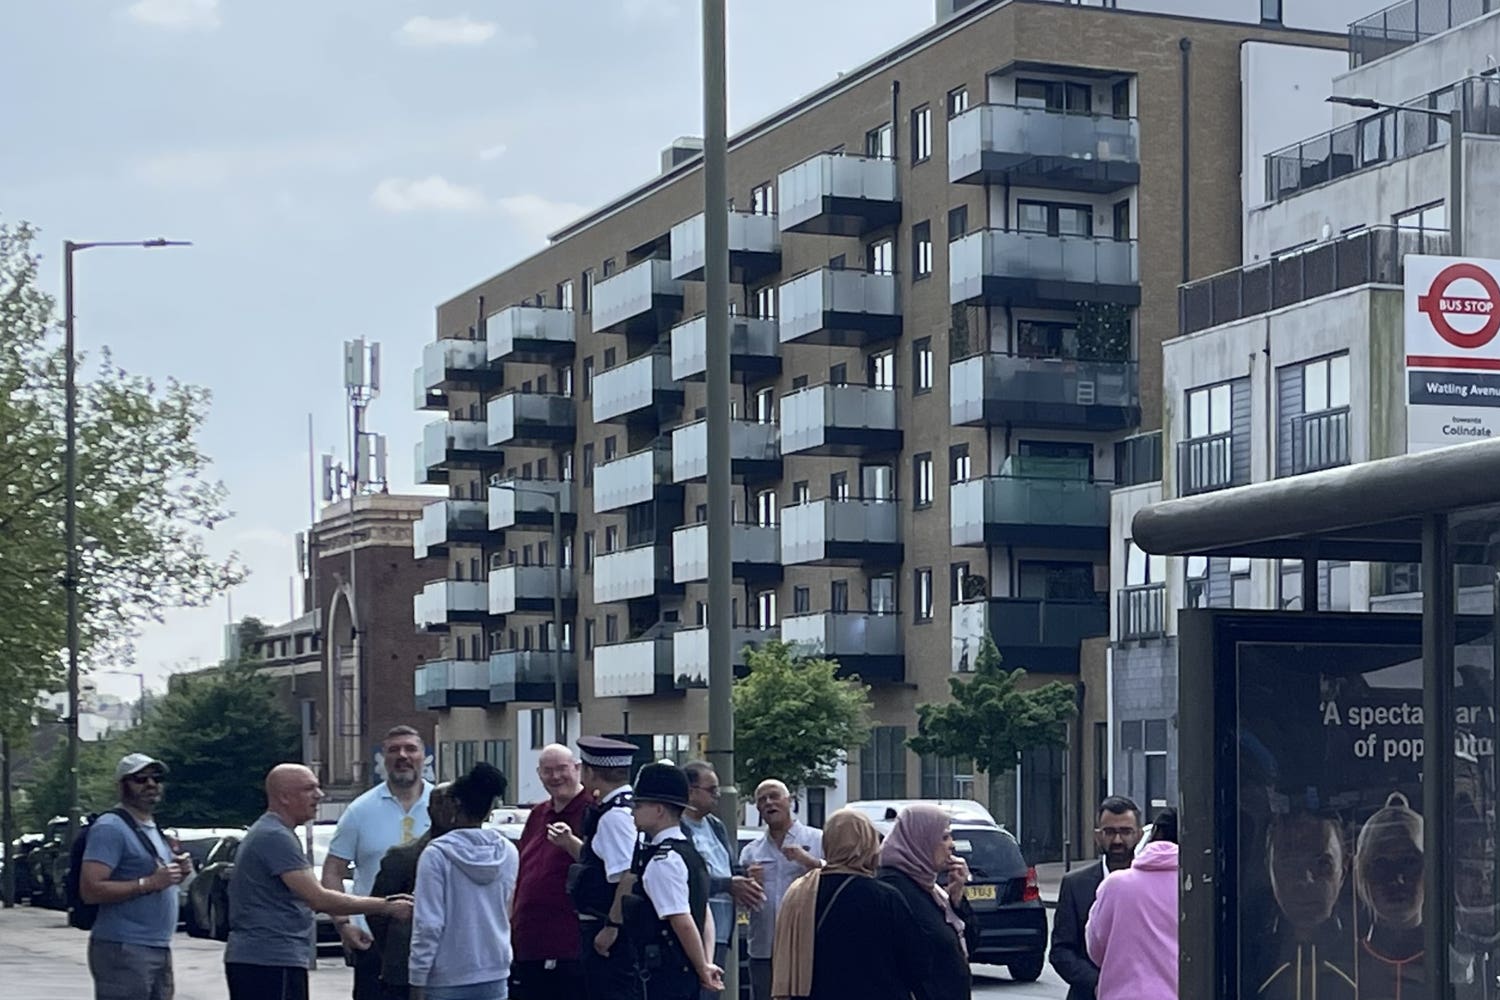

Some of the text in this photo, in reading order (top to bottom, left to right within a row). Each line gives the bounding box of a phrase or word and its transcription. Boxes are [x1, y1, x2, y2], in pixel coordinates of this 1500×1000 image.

[1439, 299, 1494, 313] BUS STOP
[1426, 382, 1468, 397] Watling
[1451, 416, 1482, 424] towards
[1442, 424, 1492, 437] Colindale
[1354, 734, 1425, 763] of pop
